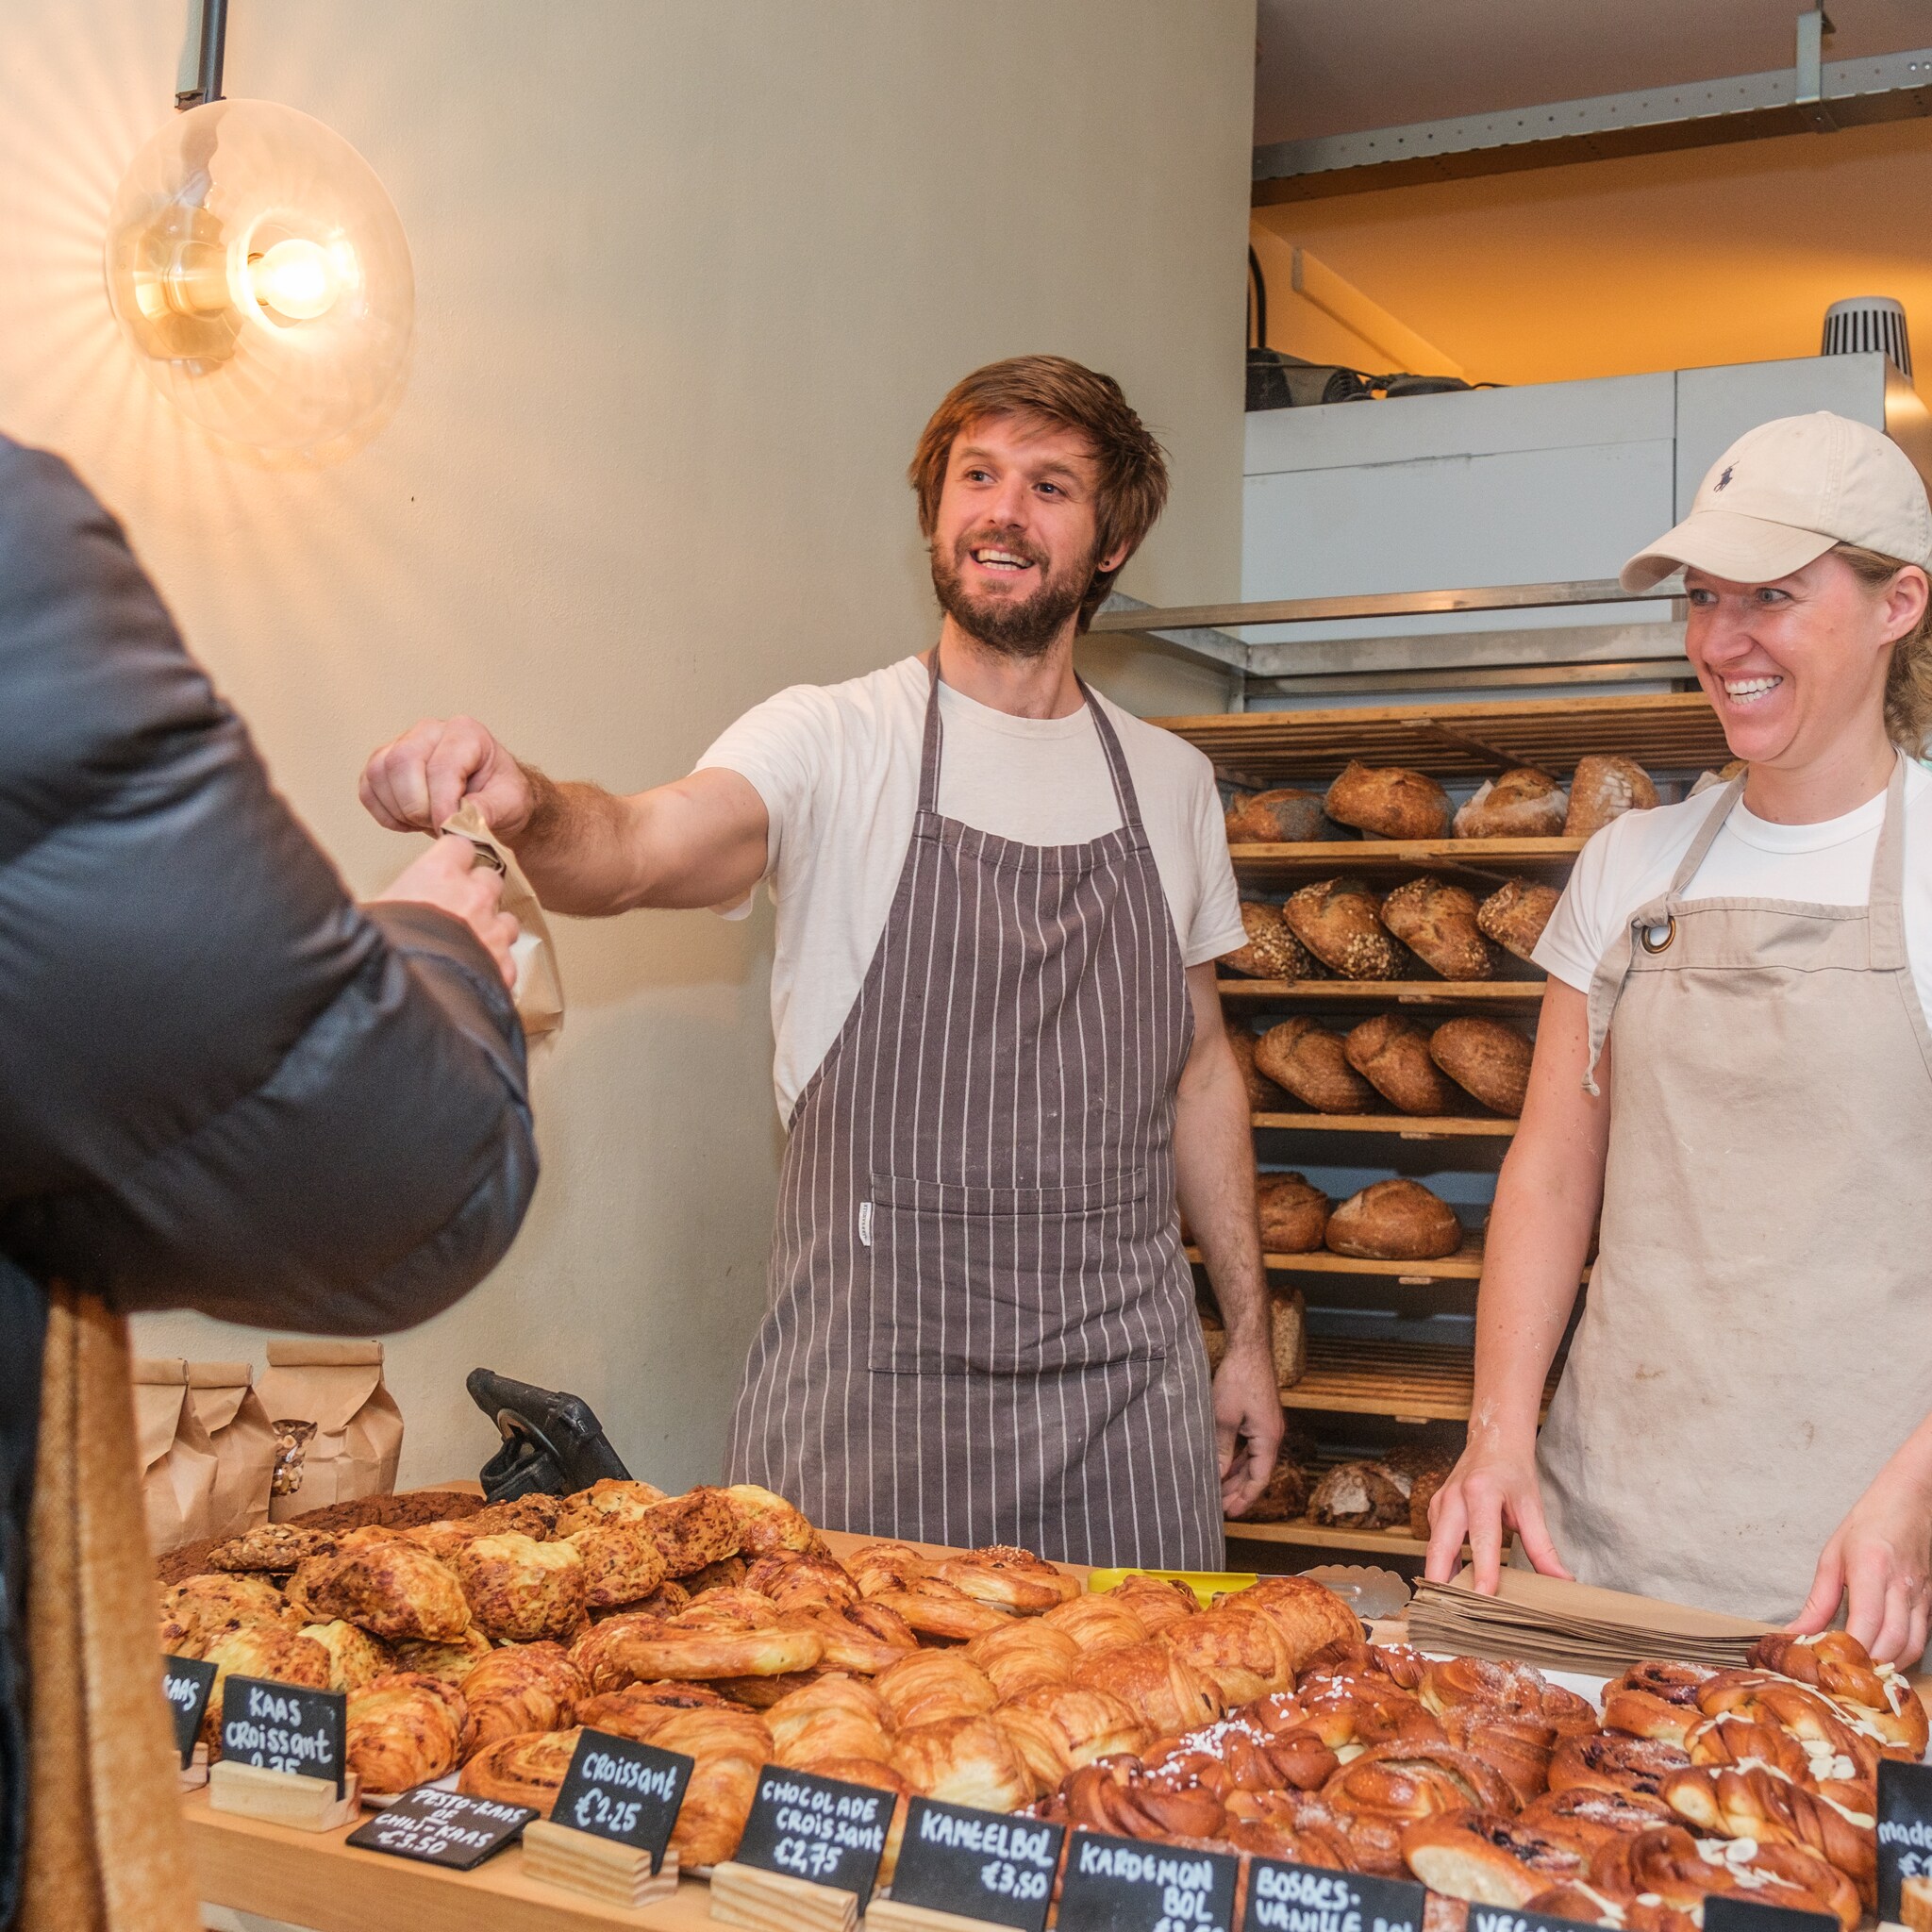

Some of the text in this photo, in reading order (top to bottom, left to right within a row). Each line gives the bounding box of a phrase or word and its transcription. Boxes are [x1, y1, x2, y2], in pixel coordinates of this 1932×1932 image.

[249, 1687, 302, 1726] KAAS
[411, 1789, 527, 1823] PESTO-KAAS
[431, 1808, 459, 1821] OF
[575, 1788, 641, 1831] €2.25
[762, 1780, 879, 1823] CHOCOLADE
[375, 1813, 493, 1848] CHILI-KAAS
[1080, 1841, 1213, 1892] KARDEMON
[1163, 1886, 1213, 1923] BOL
